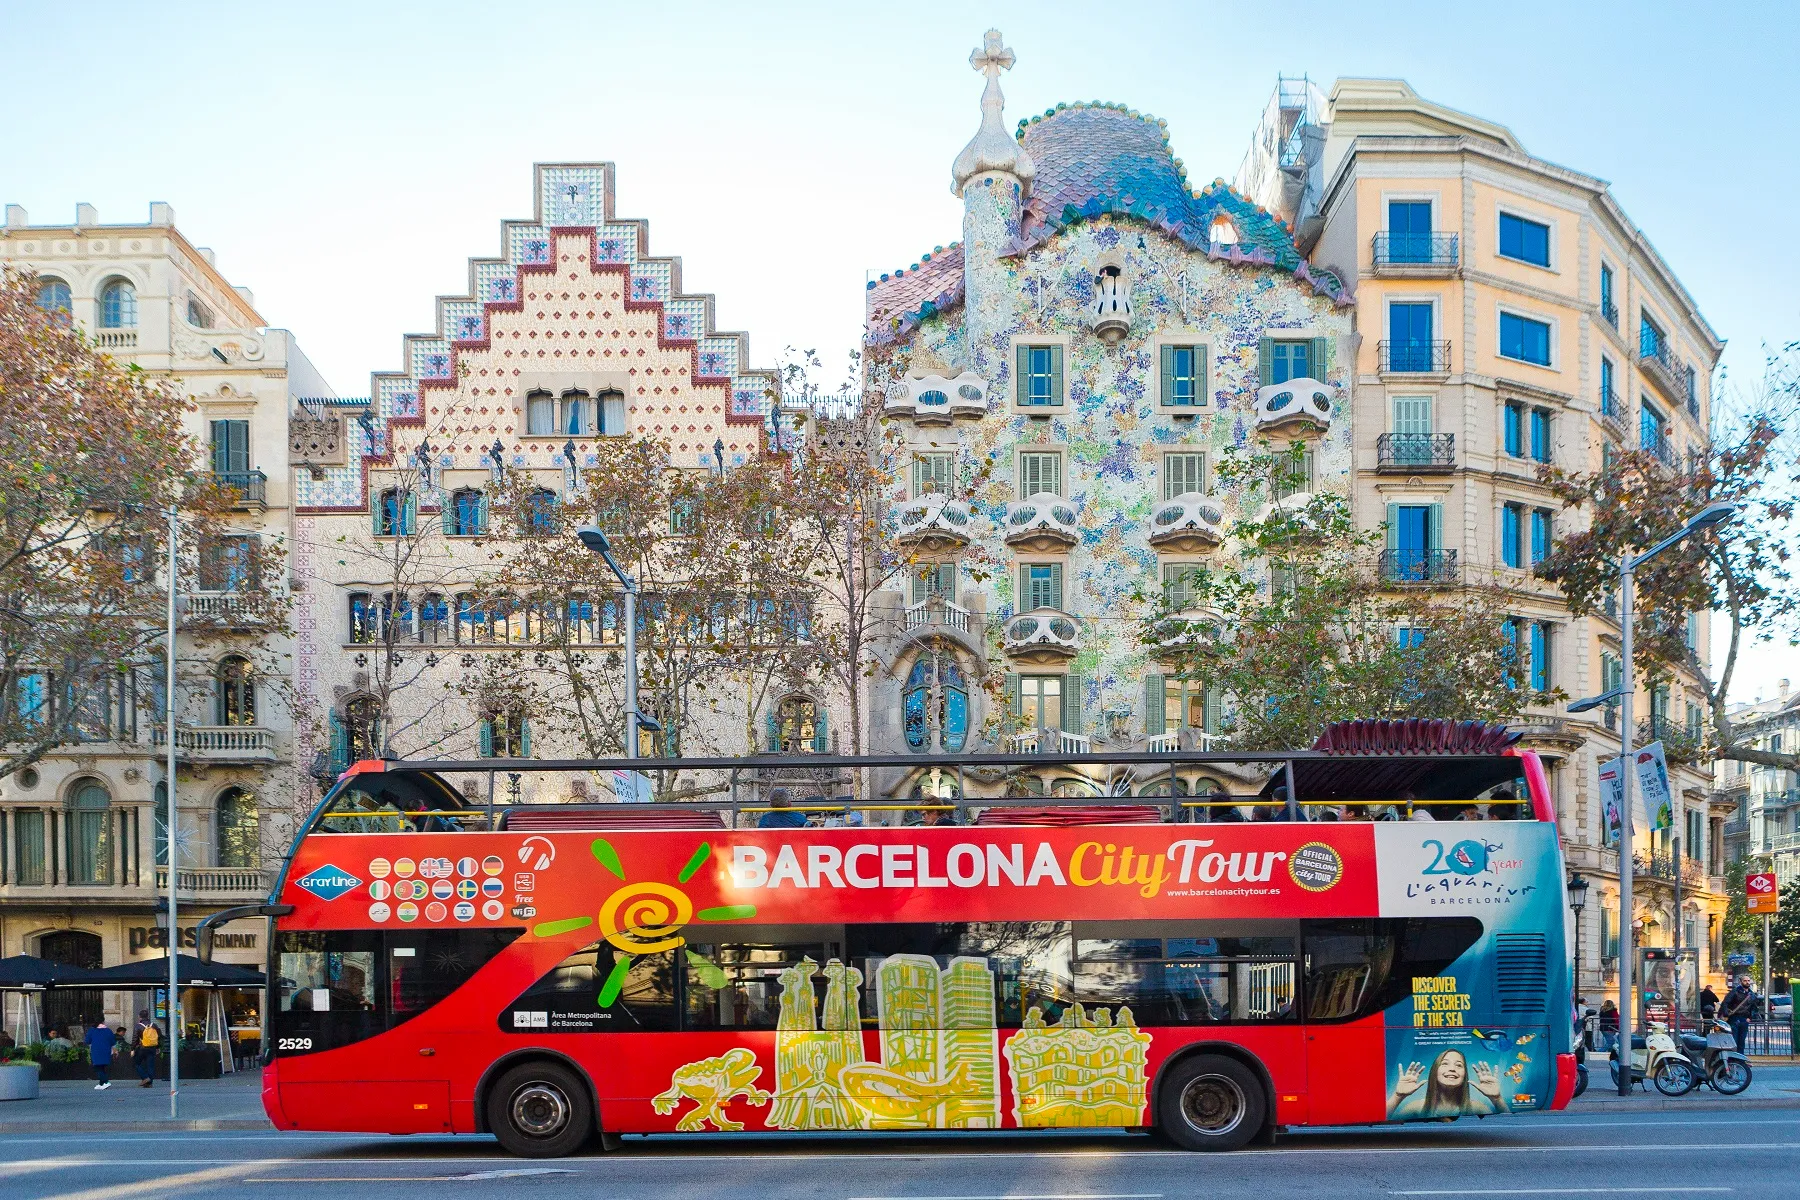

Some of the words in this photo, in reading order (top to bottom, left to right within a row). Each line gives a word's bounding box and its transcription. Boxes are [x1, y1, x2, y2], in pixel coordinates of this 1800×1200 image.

[1303, 850, 1332, 862] OFFICIAL
[733, 842, 1067, 888] BARCELONA
[1068, 841, 1171, 898] City
[1167, 839, 1286, 884] Tour
[1295, 859, 1337, 872] BARCELONA
[1295, 870, 1314, 880] city
[1314, 872, 1332, 882] TOUR
[1755, 879, 1764, 887] M
[1167, 887, 1280, 897] www.barcelonacitytour.es
[514, 894, 534, 903] Free
[1430, 897, 1511, 905] BARCELONA
[214, 933, 257, 948] COMPANY
[1412, 976, 1457, 993] DISCOVER
[1412, 994, 1430, 1011] THE
[1431, 994, 1471, 1011] SECRETS
[567, 1012, 612, 1020] Metropolitana
[1413, 1012, 1425, 1028] OF
[1427, 1012, 1444, 1028] THE
[1445, 1012, 1464, 1028] SEA
[278, 1038, 313, 1050] 2529
